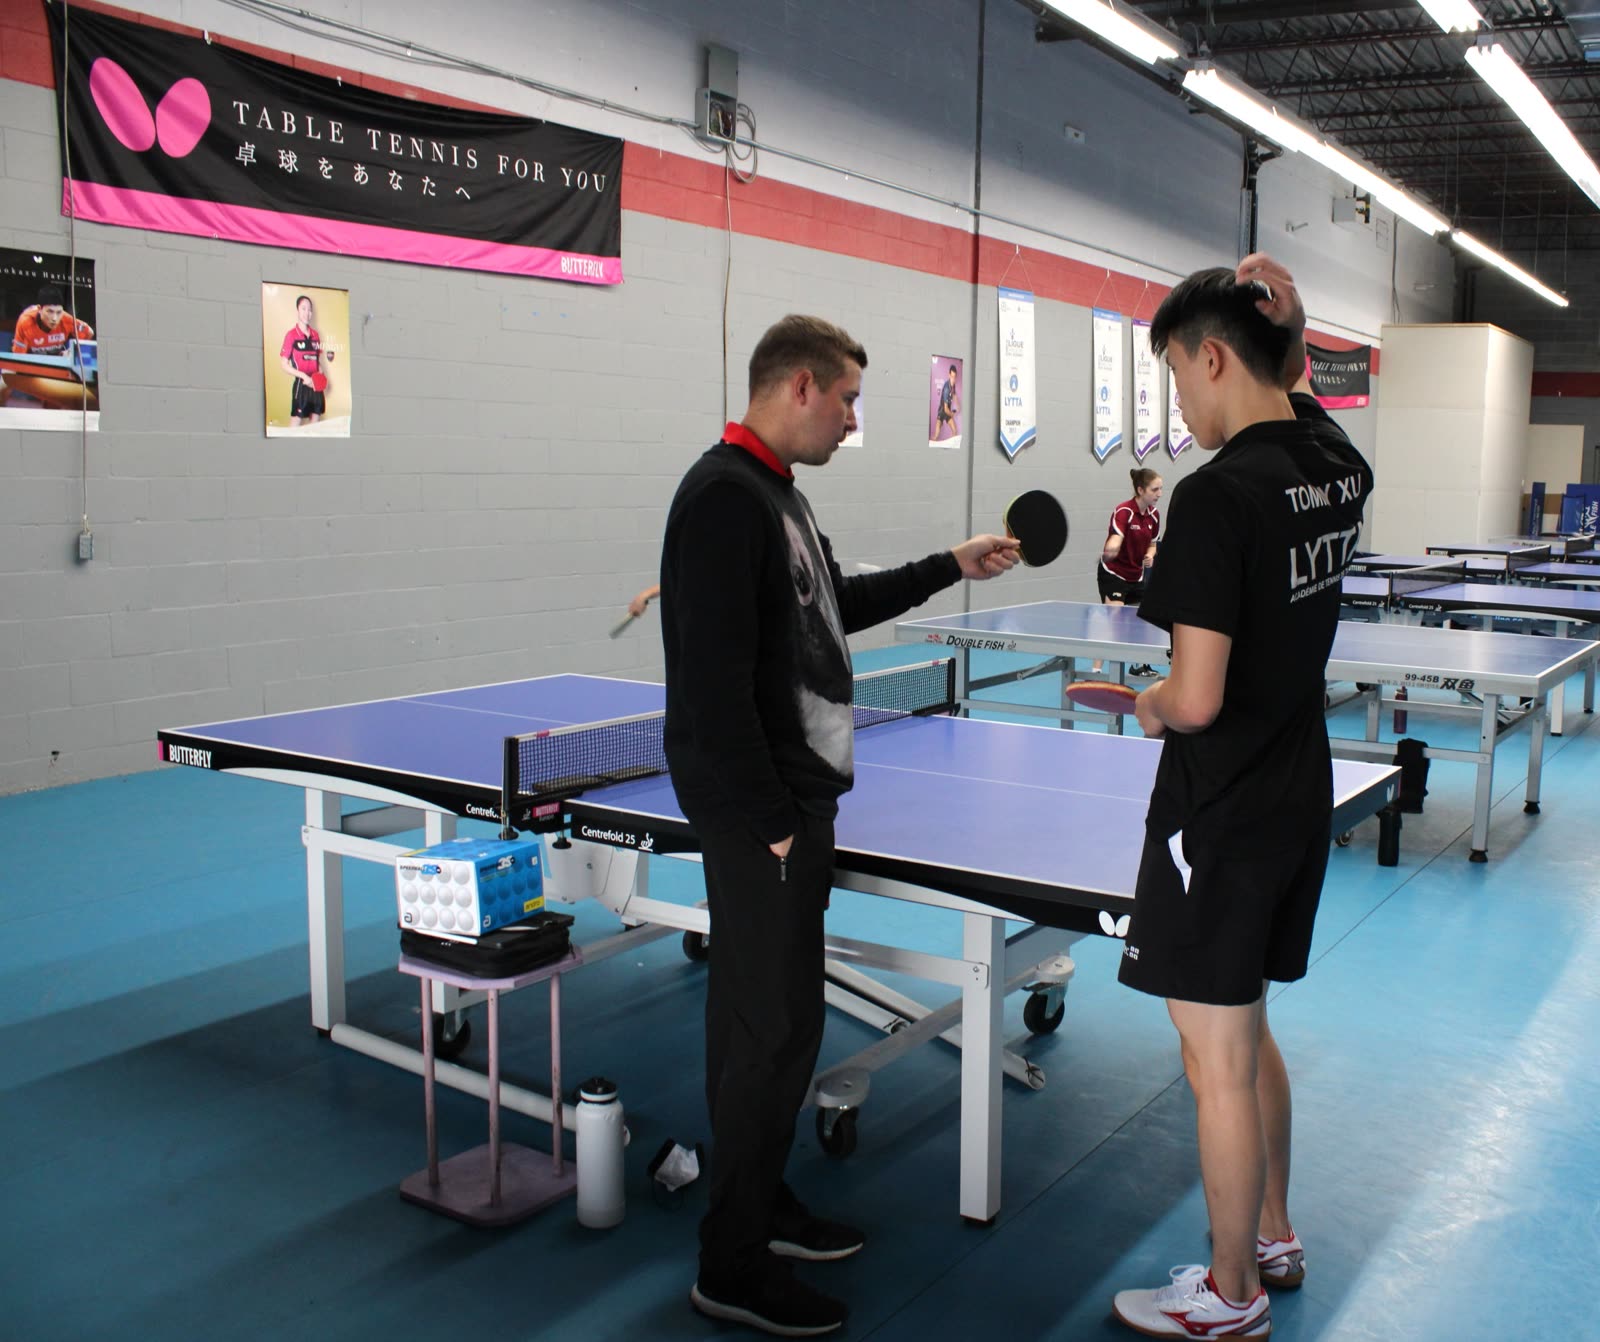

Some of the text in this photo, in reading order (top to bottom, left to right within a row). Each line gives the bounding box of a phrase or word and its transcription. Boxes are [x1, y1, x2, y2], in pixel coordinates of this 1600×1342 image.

[233, 101, 606, 192] TABLE TENNIS FOR YOU
[235, 141, 471, 200] 卓球をあなたへ
[561, 256, 604, 278] BUTTERFLY
[1004, 396, 1023, 407] LYTTA
[1170, 409, 1182, 417] LYTT
[1336, 473, 1361, 504] XU
[946, 635, 982, 649] DOUBLE
[984, 640, 1005, 650] FISH
[1405, 673, 1439, 683] 99-45B
[169, 744, 212, 769] BUTTERFLY
[466, 803, 499, 819] Centrefo
[581, 825, 636, 845] Centrefold 25
